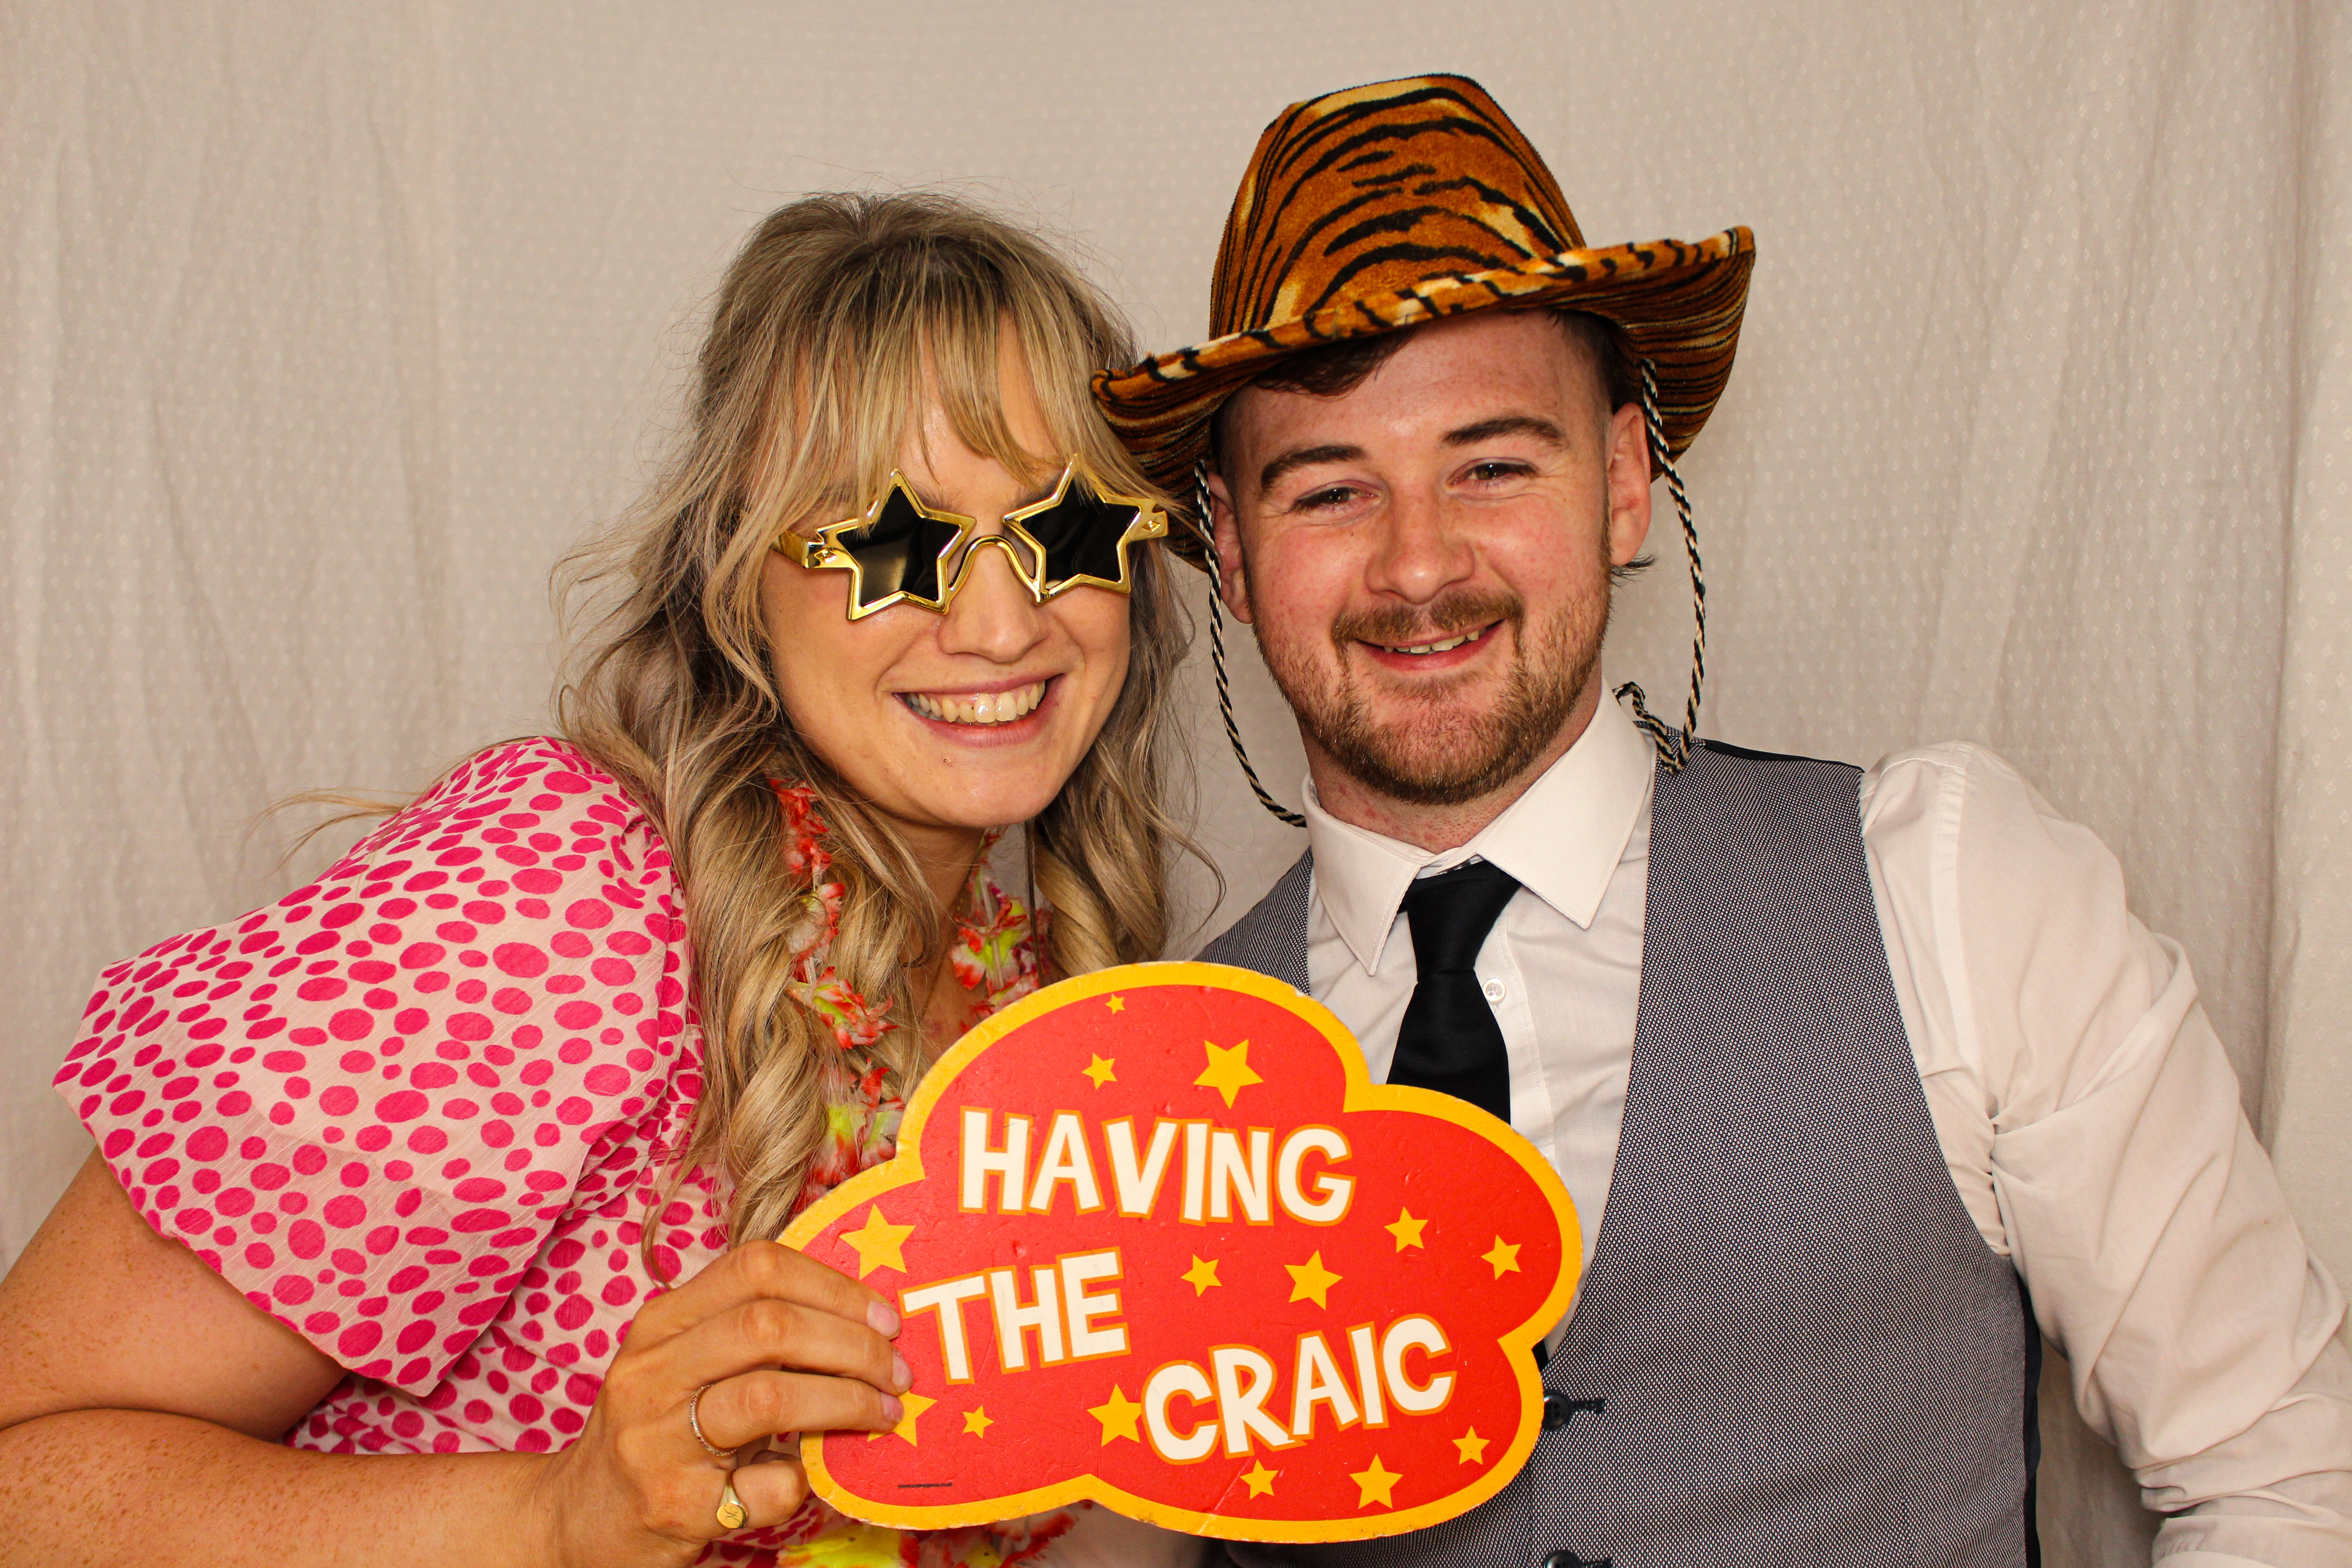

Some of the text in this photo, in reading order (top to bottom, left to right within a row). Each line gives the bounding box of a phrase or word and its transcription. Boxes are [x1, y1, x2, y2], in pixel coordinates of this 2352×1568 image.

[961, 1108, 1354, 1224] HAVING
[901, 1250, 1129, 1382] THE
[1142, 1316, 1454, 1462] CRAIC
